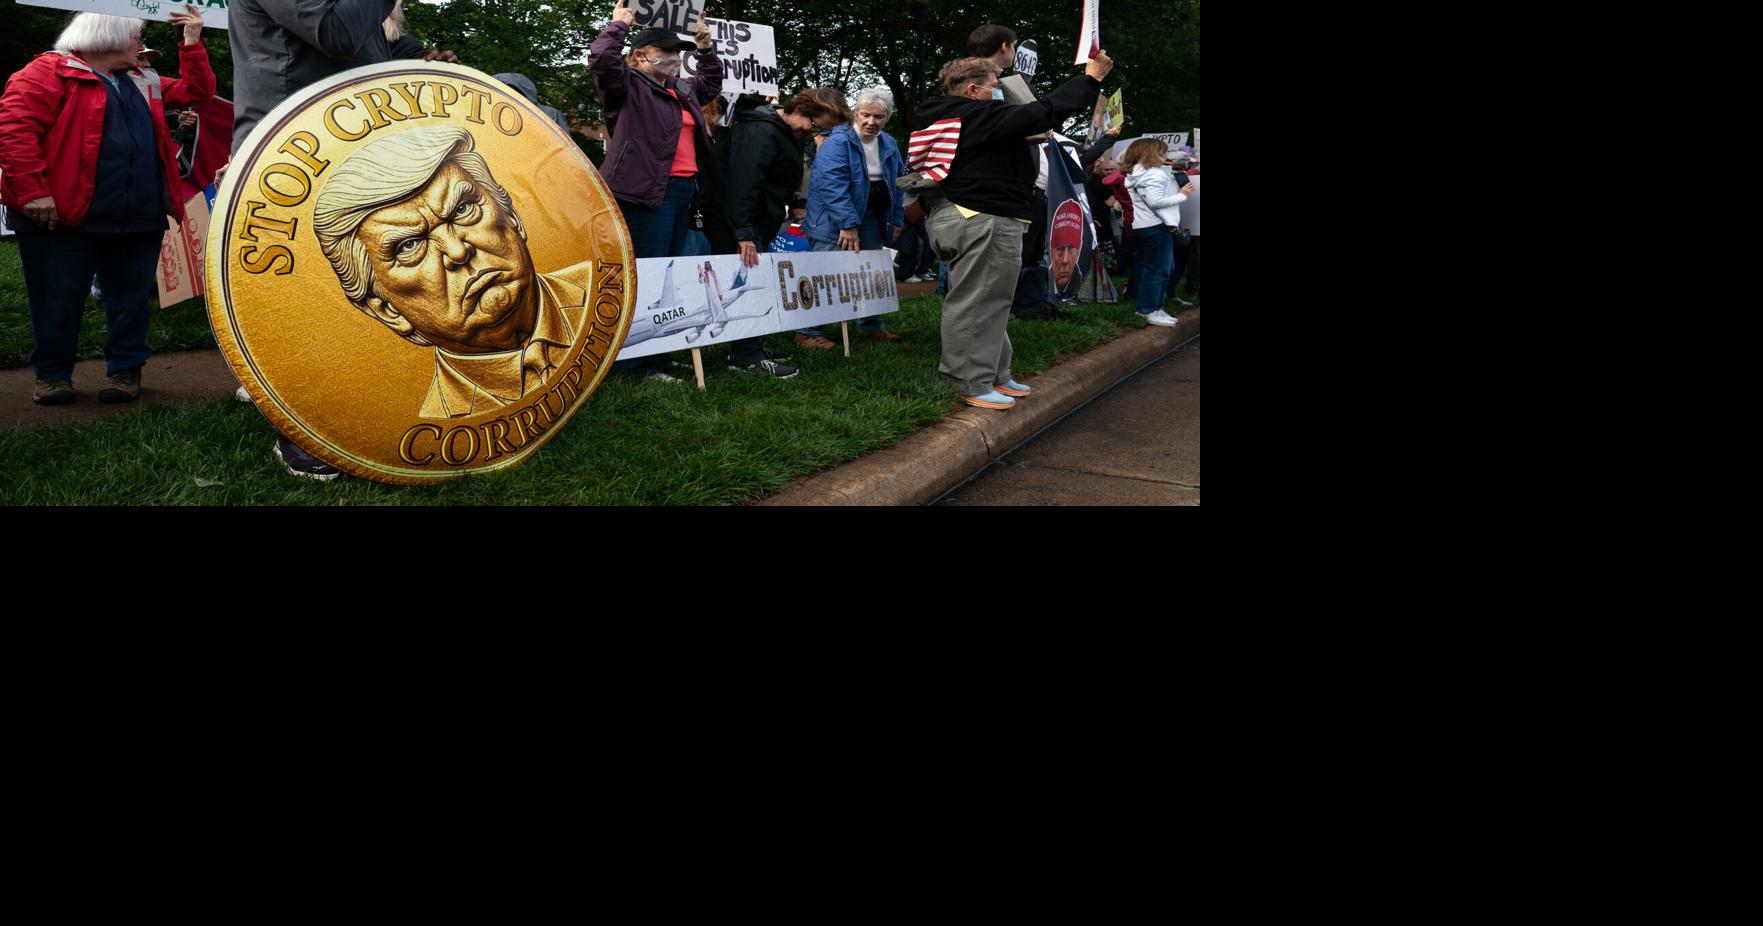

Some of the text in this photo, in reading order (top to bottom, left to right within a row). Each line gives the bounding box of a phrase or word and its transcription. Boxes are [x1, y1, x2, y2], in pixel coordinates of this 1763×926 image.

[634, 0, 699, 37] SALE
[683, 50, 777, 89] Cruption
[1014, 50, 1038, 75] 8647
[239, 130, 330, 276] STOP
[324, 81, 523, 142] CRYPTO
[777, 260, 897, 312] Corruption
[653, 306, 686, 325] QATAR
[398, 259, 623, 466] CORRUPTION
